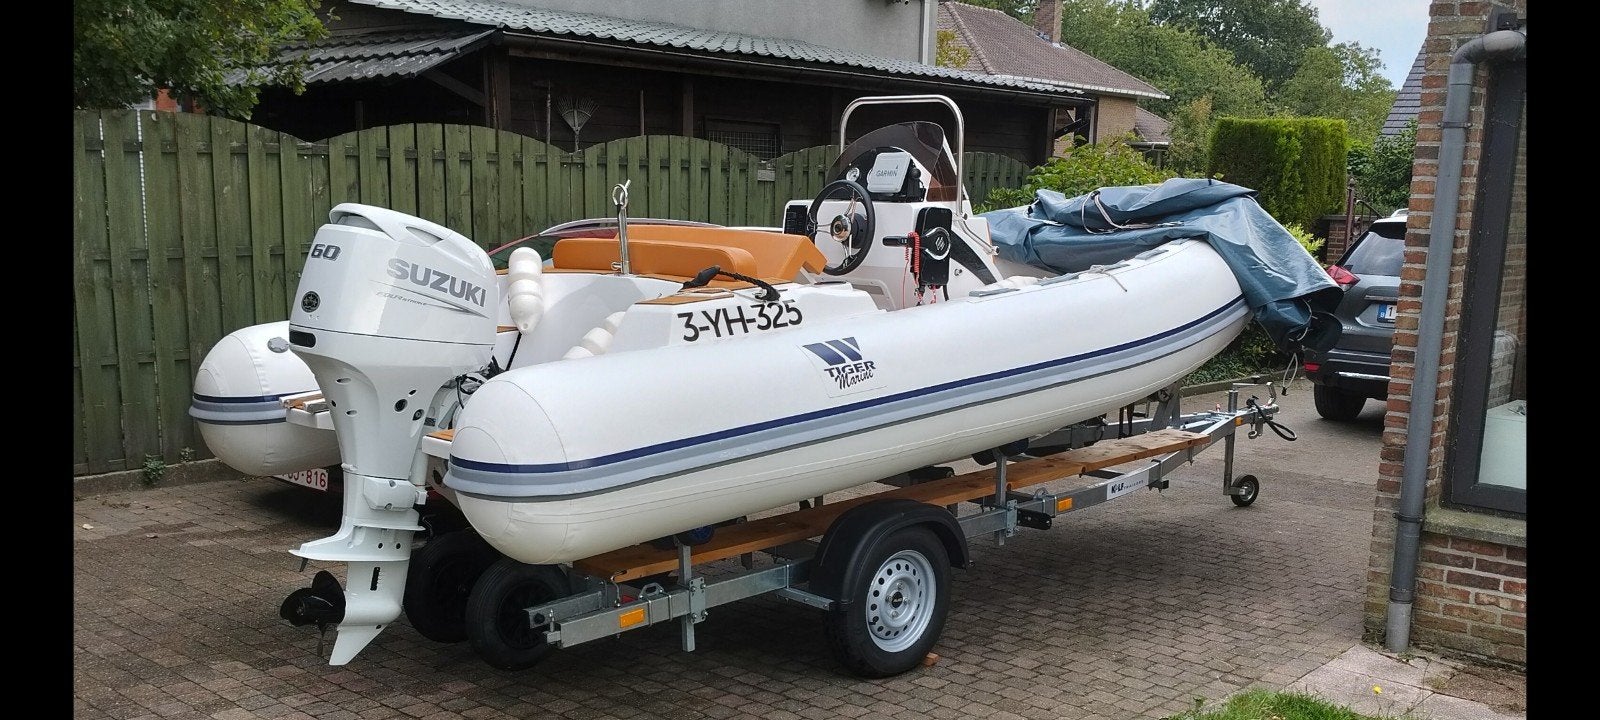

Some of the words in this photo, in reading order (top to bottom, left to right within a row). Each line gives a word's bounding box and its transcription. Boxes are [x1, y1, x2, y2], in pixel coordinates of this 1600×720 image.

[876, 169, 897, 177] GARMIN
[311, 243, 342, 261] 60
[386, 258, 486, 307] SUZUKI
[677, 299, 803, 342] 3-YH-325
[824, 360, 876, 377] TIGER
[834, 369, 873, 389] Marine
